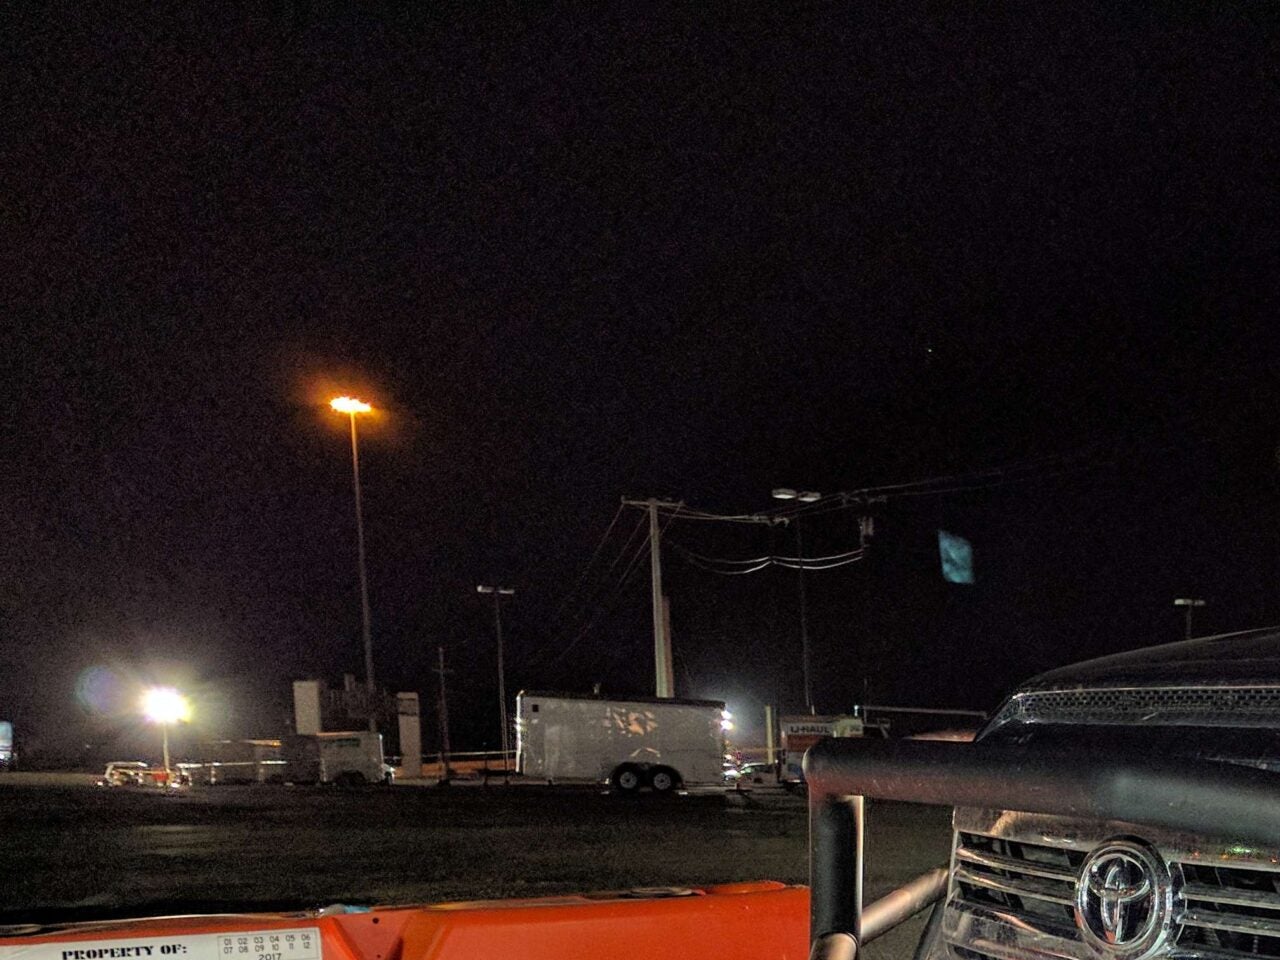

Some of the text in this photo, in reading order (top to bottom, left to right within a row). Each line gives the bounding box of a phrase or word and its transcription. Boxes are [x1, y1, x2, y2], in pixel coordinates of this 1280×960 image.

[224, 938, 232, 946] 01
[254, 936, 264, 944] 03
[285, 934, 295, 942] 05
[62, 944, 187, 960] PROPERTY OF:
[224, 946, 233, 954] 07
[255, 944, 264, 952] 09
